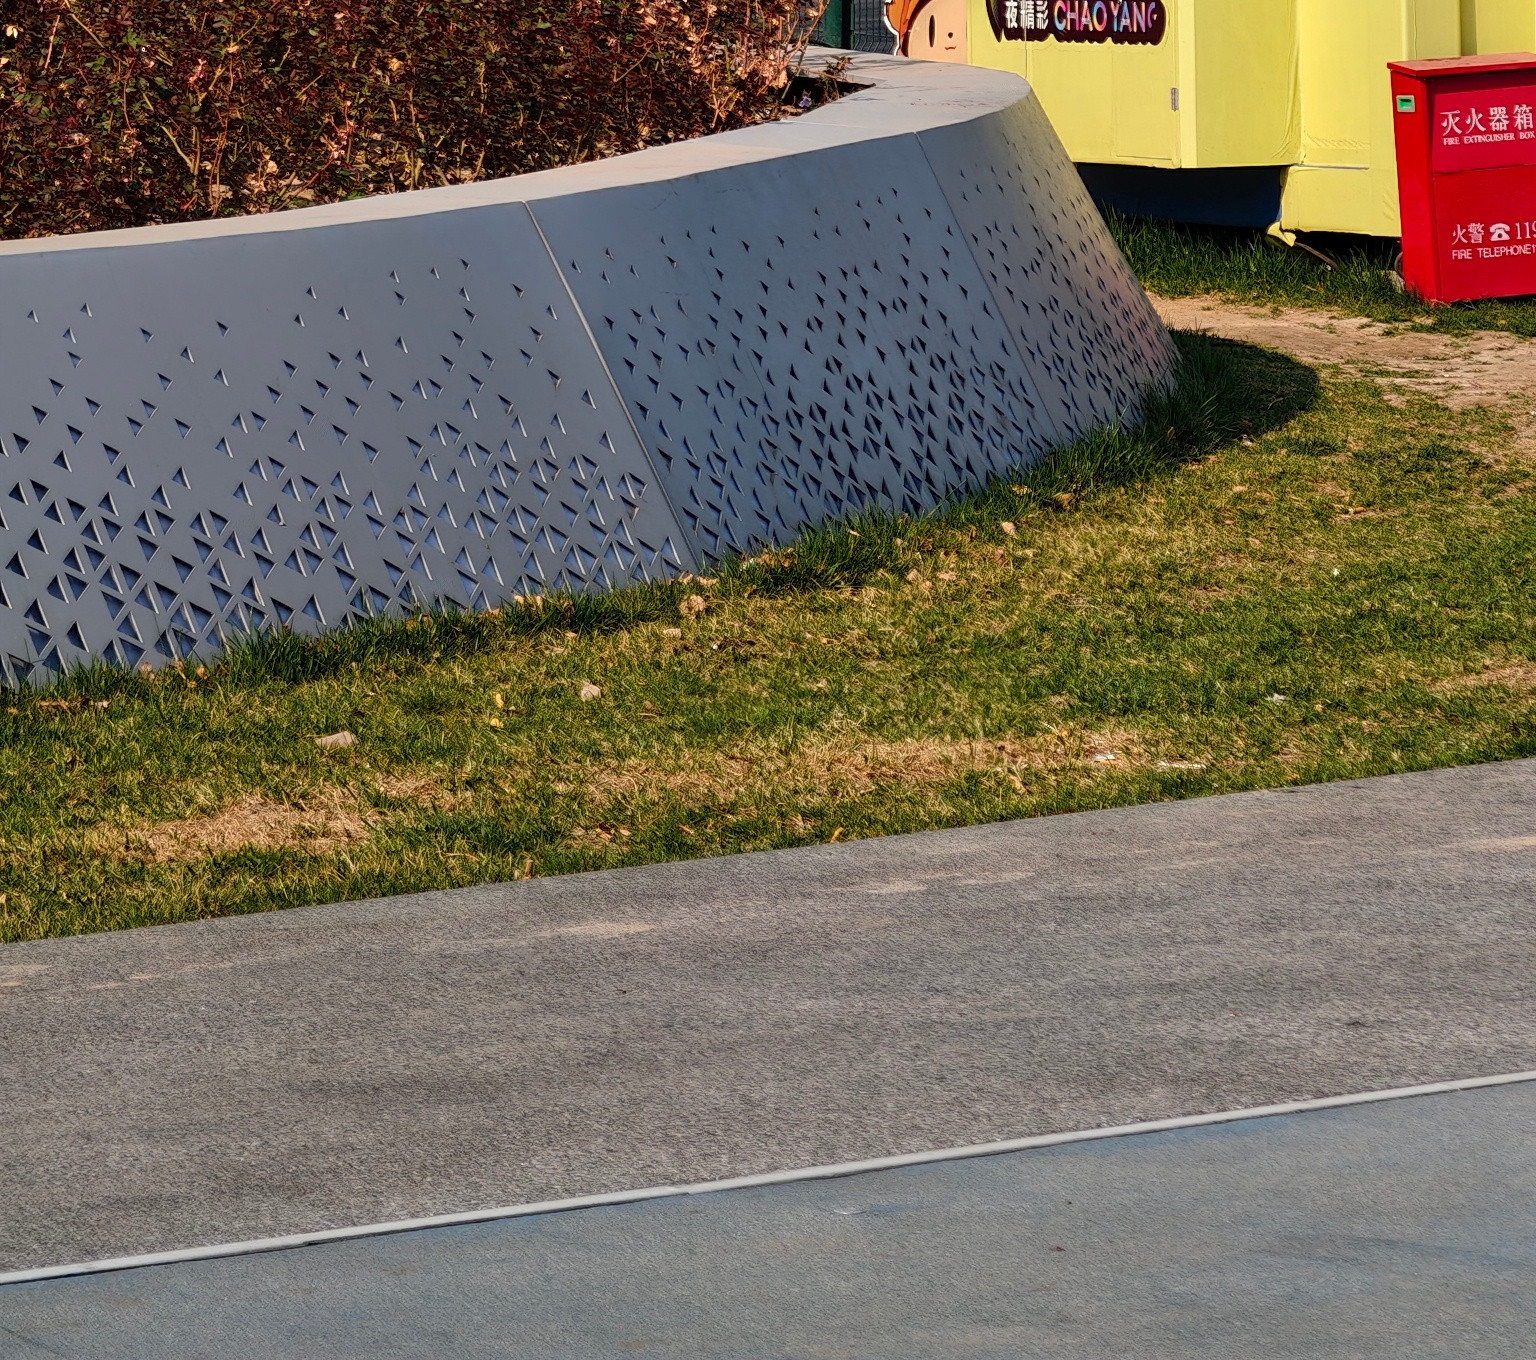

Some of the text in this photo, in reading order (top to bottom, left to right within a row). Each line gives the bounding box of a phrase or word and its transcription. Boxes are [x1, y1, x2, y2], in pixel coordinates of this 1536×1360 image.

[1005, 0, 1049, 30] 夜精彩
[1054, 0, 1107, 32] CHAO
[1440, 104, 1534, 136] 灭火器箱
[1443, 131, 1535, 145] FIRE EXTINGUISHER BOX
[1451, 222, 1484, 245] 火警
[1452, 249, 1472, 260] FIRE
